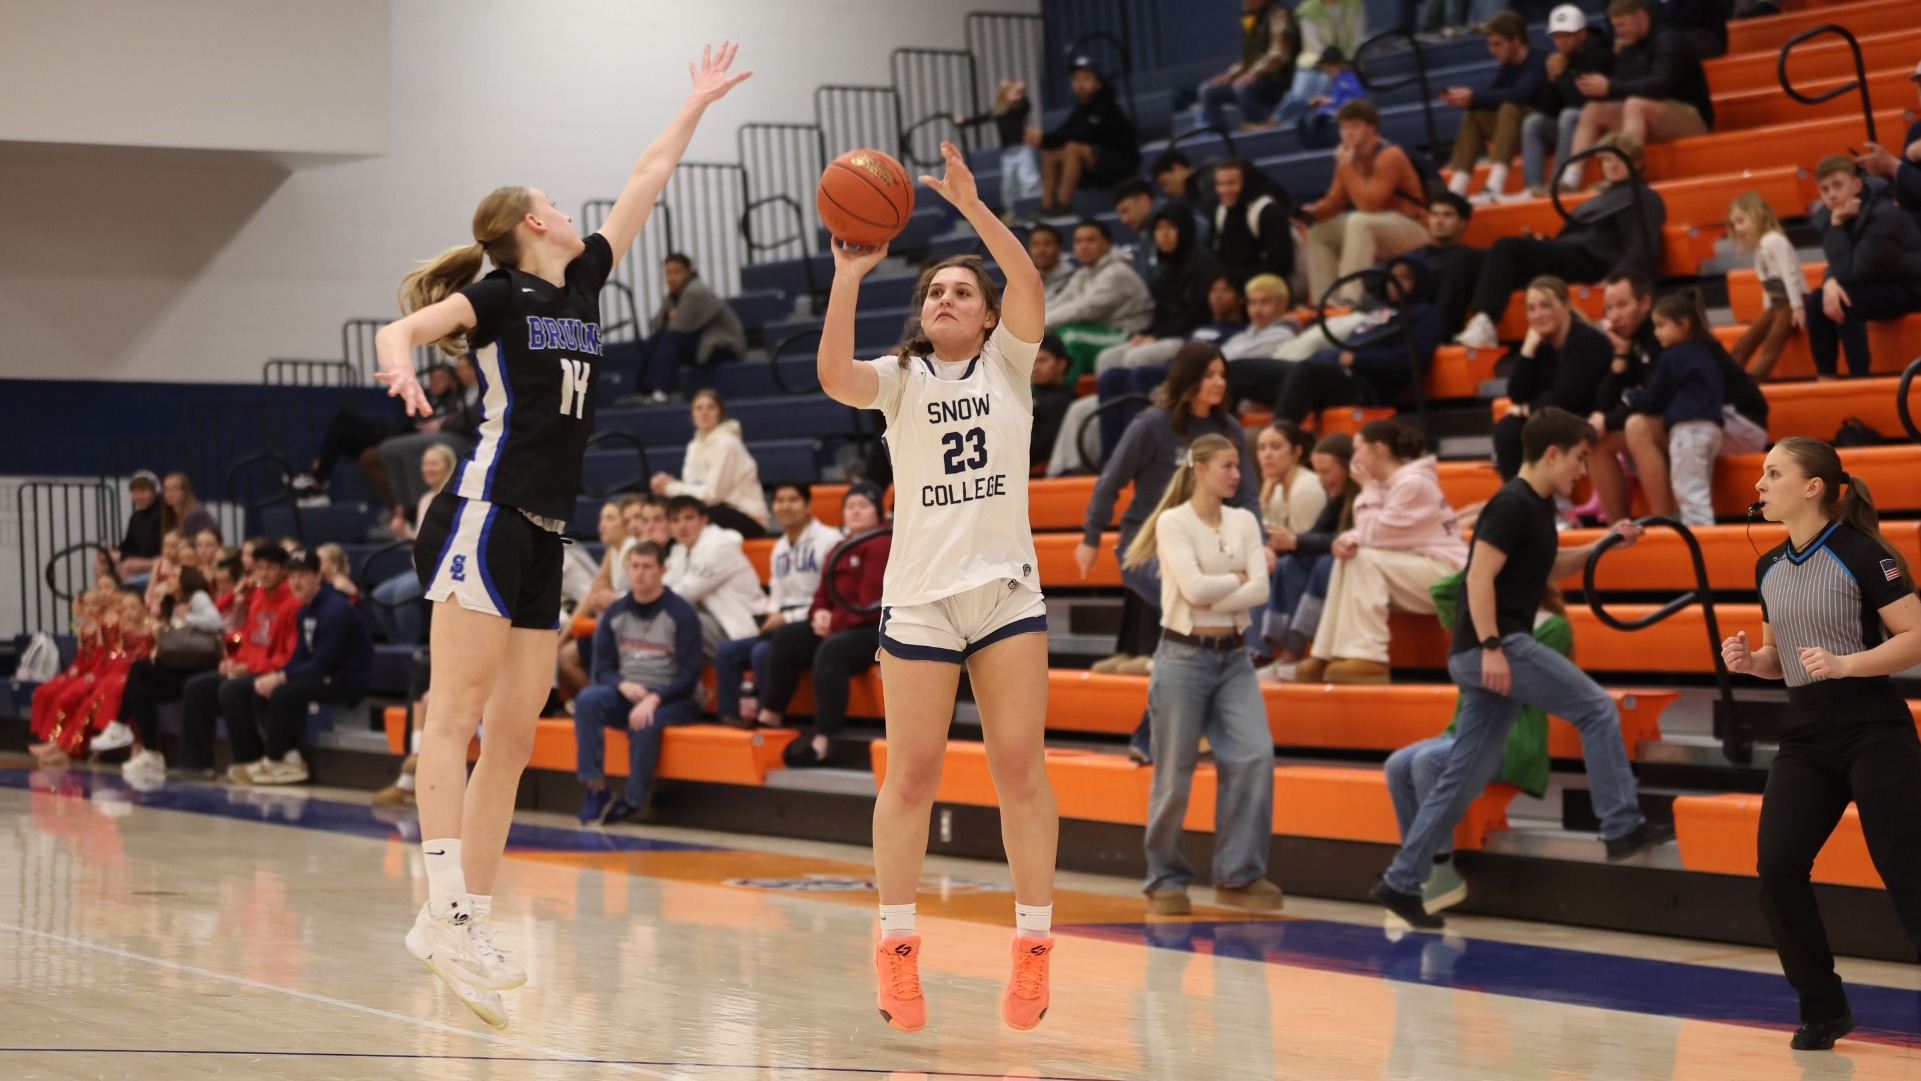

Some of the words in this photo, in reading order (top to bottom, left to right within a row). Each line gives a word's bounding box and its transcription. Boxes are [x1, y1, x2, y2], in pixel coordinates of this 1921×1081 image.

[560, 358, 590, 419] 14
[927, 393, 990, 424] SNOW
[941, 427, 988, 475] 23
[922, 474, 1006, 507] COLLEGE
